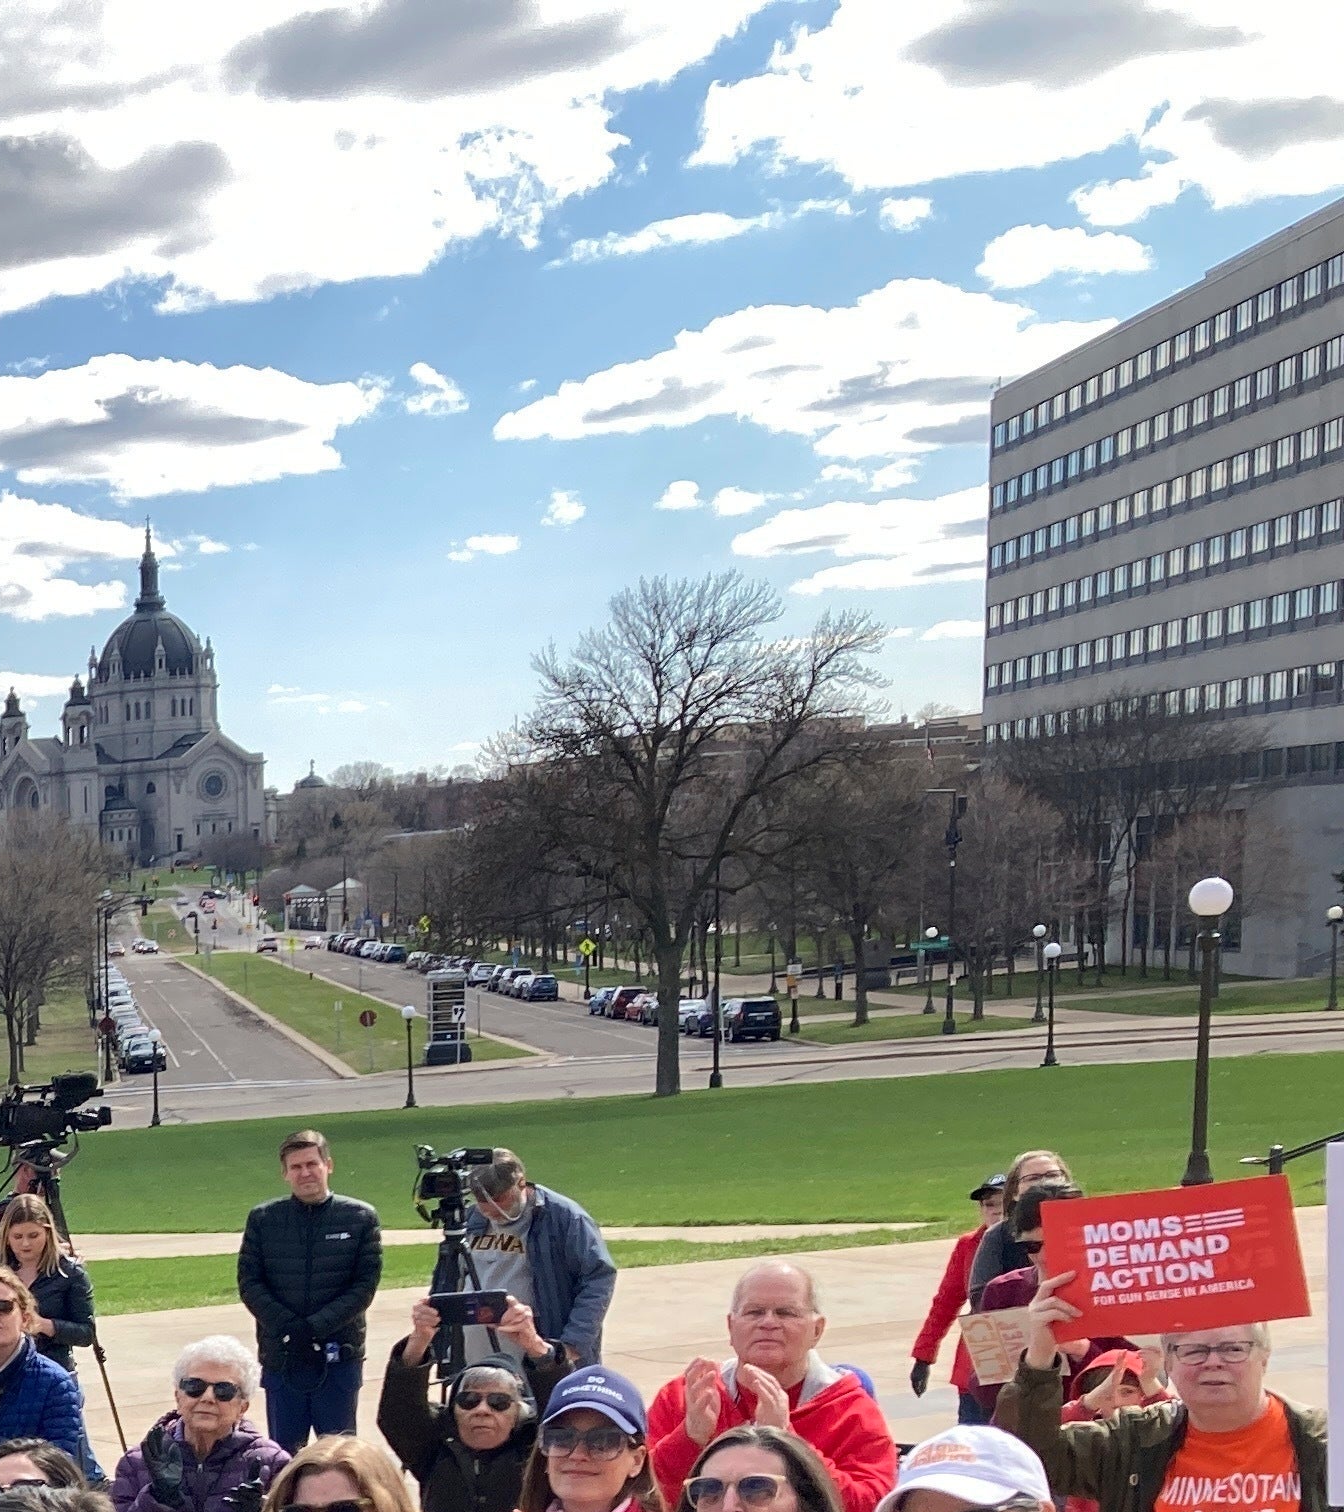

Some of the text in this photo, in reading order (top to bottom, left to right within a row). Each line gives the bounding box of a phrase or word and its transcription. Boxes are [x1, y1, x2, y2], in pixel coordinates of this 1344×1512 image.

[471, 1233, 525, 1254] IOWA
[1083, 1215, 1184, 1245] MOMS
[1086, 1234, 1230, 1269] DEMAND
[1090, 1259, 1215, 1293] ACTION
[1093, 1277, 1256, 1307] FOR GUN SENSE IN AMERICA
